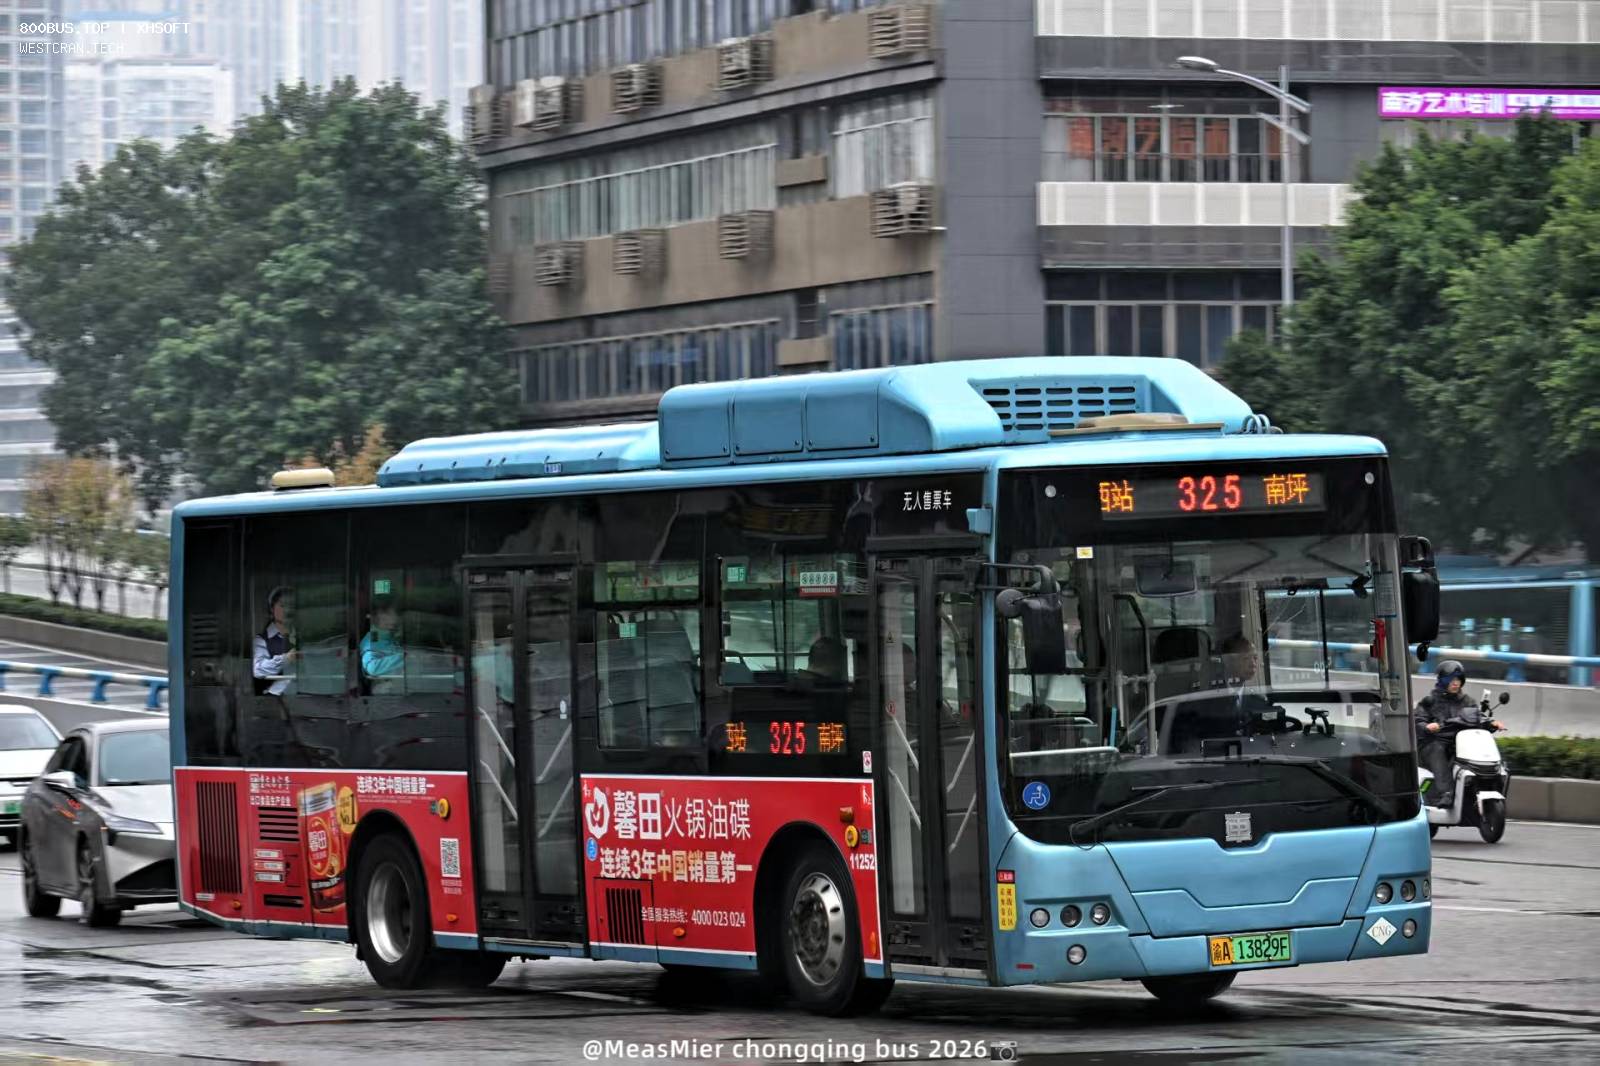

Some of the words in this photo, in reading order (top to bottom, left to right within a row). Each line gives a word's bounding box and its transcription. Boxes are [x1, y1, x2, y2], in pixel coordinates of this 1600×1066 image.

[902, 489, 952, 511] 无人售票车
[1178, 475, 1242, 511] 325
[1263, 473, 1309, 505] 南坪
[769, 721, 806, 755] 325
[600, 847, 753, 884] 连续3年中国销量第一
[850, 853, 875, 870] 11252
[692, 909, 711, 926] 4000
[713, 911, 728, 926] 023
[730, 911, 746, 928] 024
[1372, 925, 1391, 938] CNG
[1213, 942, 1231, 962] 渝A
[1238, 937, 1288, 960] 13829F
